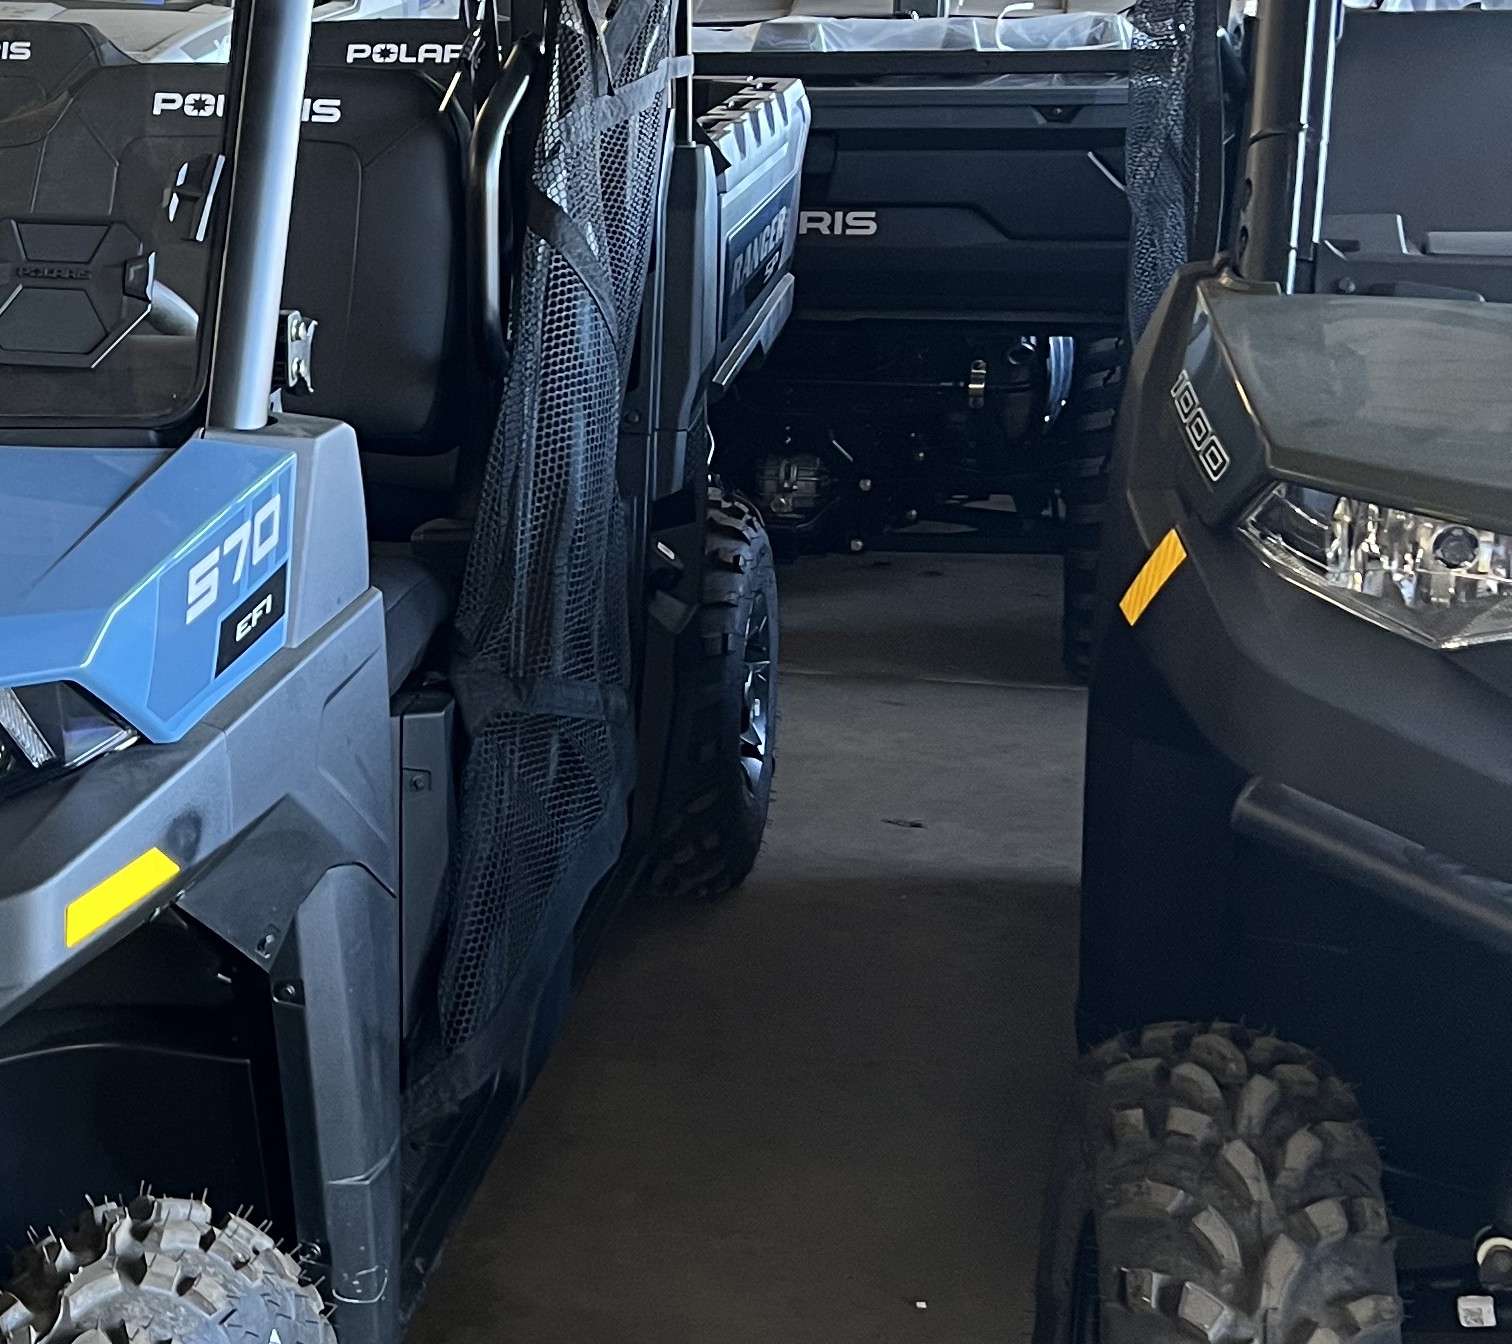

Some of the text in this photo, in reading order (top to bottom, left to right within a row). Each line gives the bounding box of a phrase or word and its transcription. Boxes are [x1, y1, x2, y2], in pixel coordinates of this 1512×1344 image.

[730, 206, 787, 296] RANGER
[1170, 369, 1230, 482] 1000
[186, 493, 281, 625] 570
[235, 593, 273, 642] EFI
